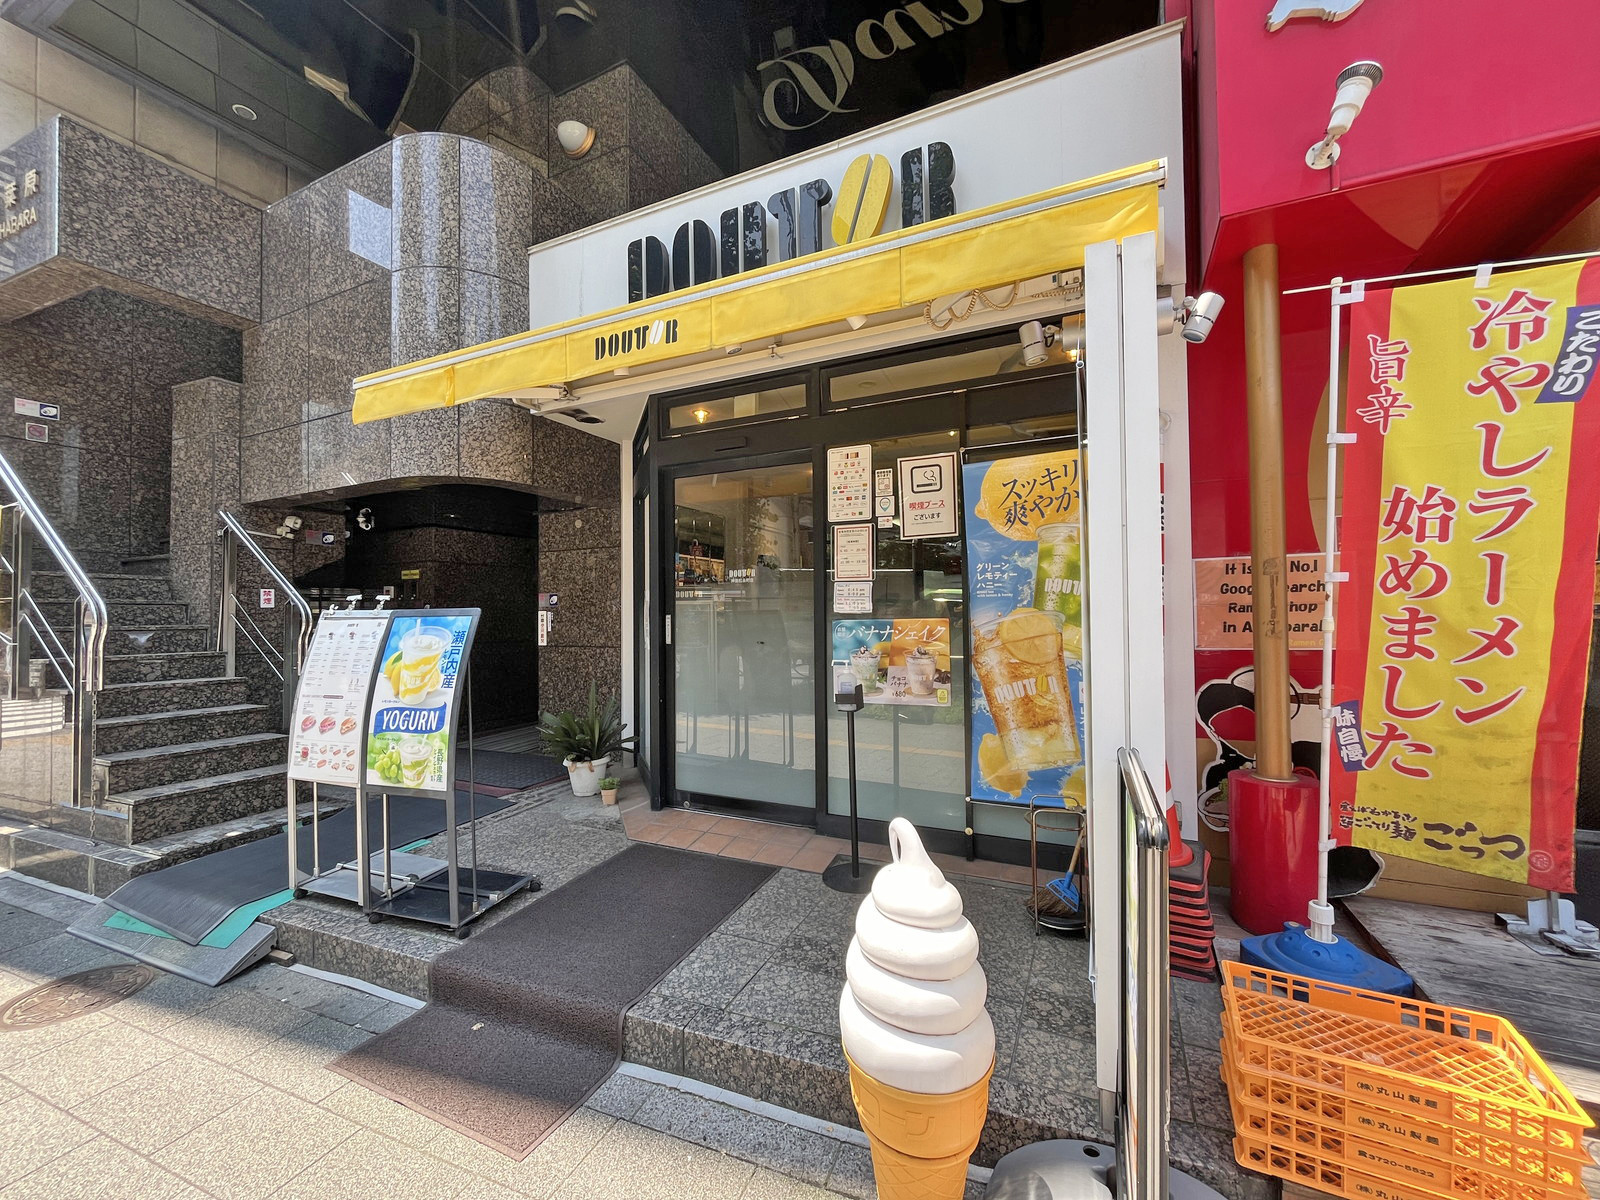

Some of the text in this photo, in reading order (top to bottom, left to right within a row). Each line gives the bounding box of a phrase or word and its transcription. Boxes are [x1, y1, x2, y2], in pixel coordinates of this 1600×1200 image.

[626, 140, 956, 303] DOUTOR
[594, 318, 679, 361] DOUTOR
[1552, 310, 1600, 396] こだわり
[1356, 332, 1413, 436] 旨辛
[997, 459, 1079, 509] スッキリ
[1453, 288, 1556, 727] 冷やしラーメン
[913, 512, 941, 521] ございます
[976, 562, 1010, 572] グリーン
[847, 624, 947, 642] バナナシェイク
[1223, 621, 1237, 633] in
[1362, 483, 1460, 780] 始めました
[441, 630, 467, 689] 瀬戸内産
[382, 709, 440, 731] YOGURN
